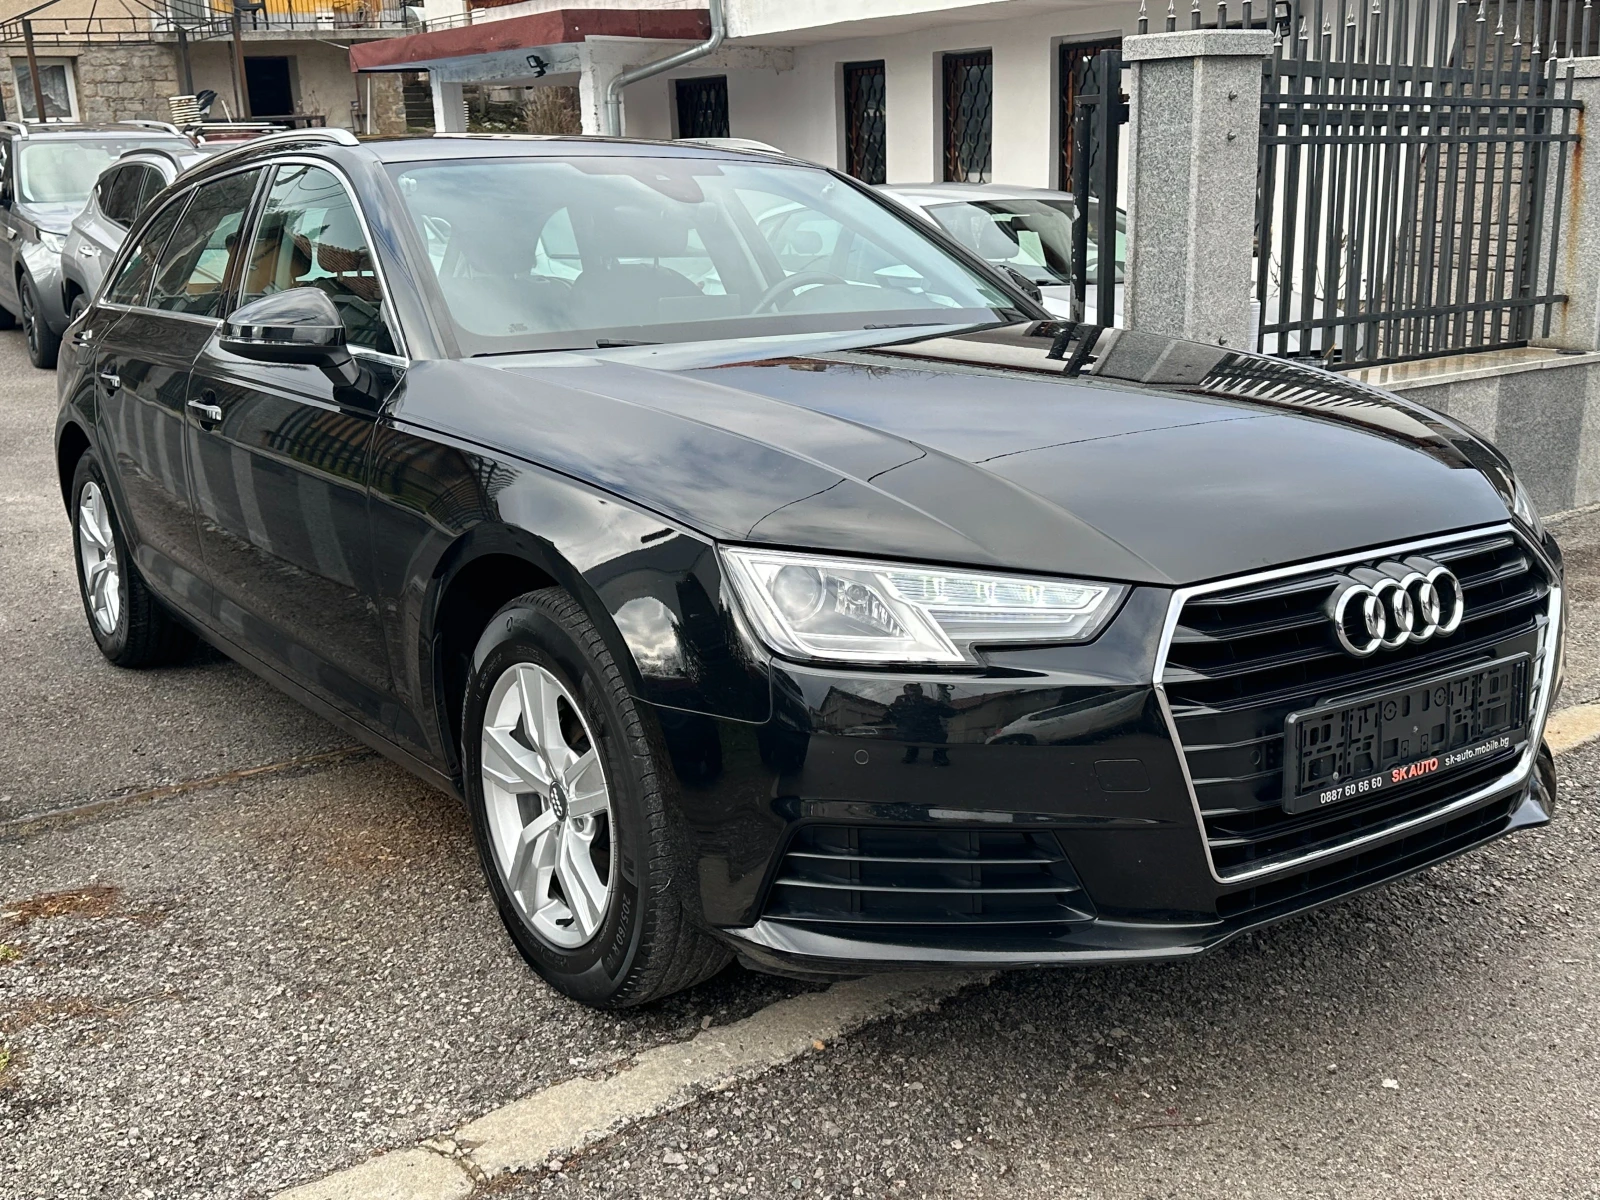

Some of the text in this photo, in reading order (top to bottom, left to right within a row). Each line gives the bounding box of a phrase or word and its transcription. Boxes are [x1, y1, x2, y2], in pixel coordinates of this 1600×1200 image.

[1445, 737, 1510, 766] sk-auto.mobile.bg
[1320, 776, 1383, 804] 0887 60 66 60
[615, 893, 632, 946] 205/60
